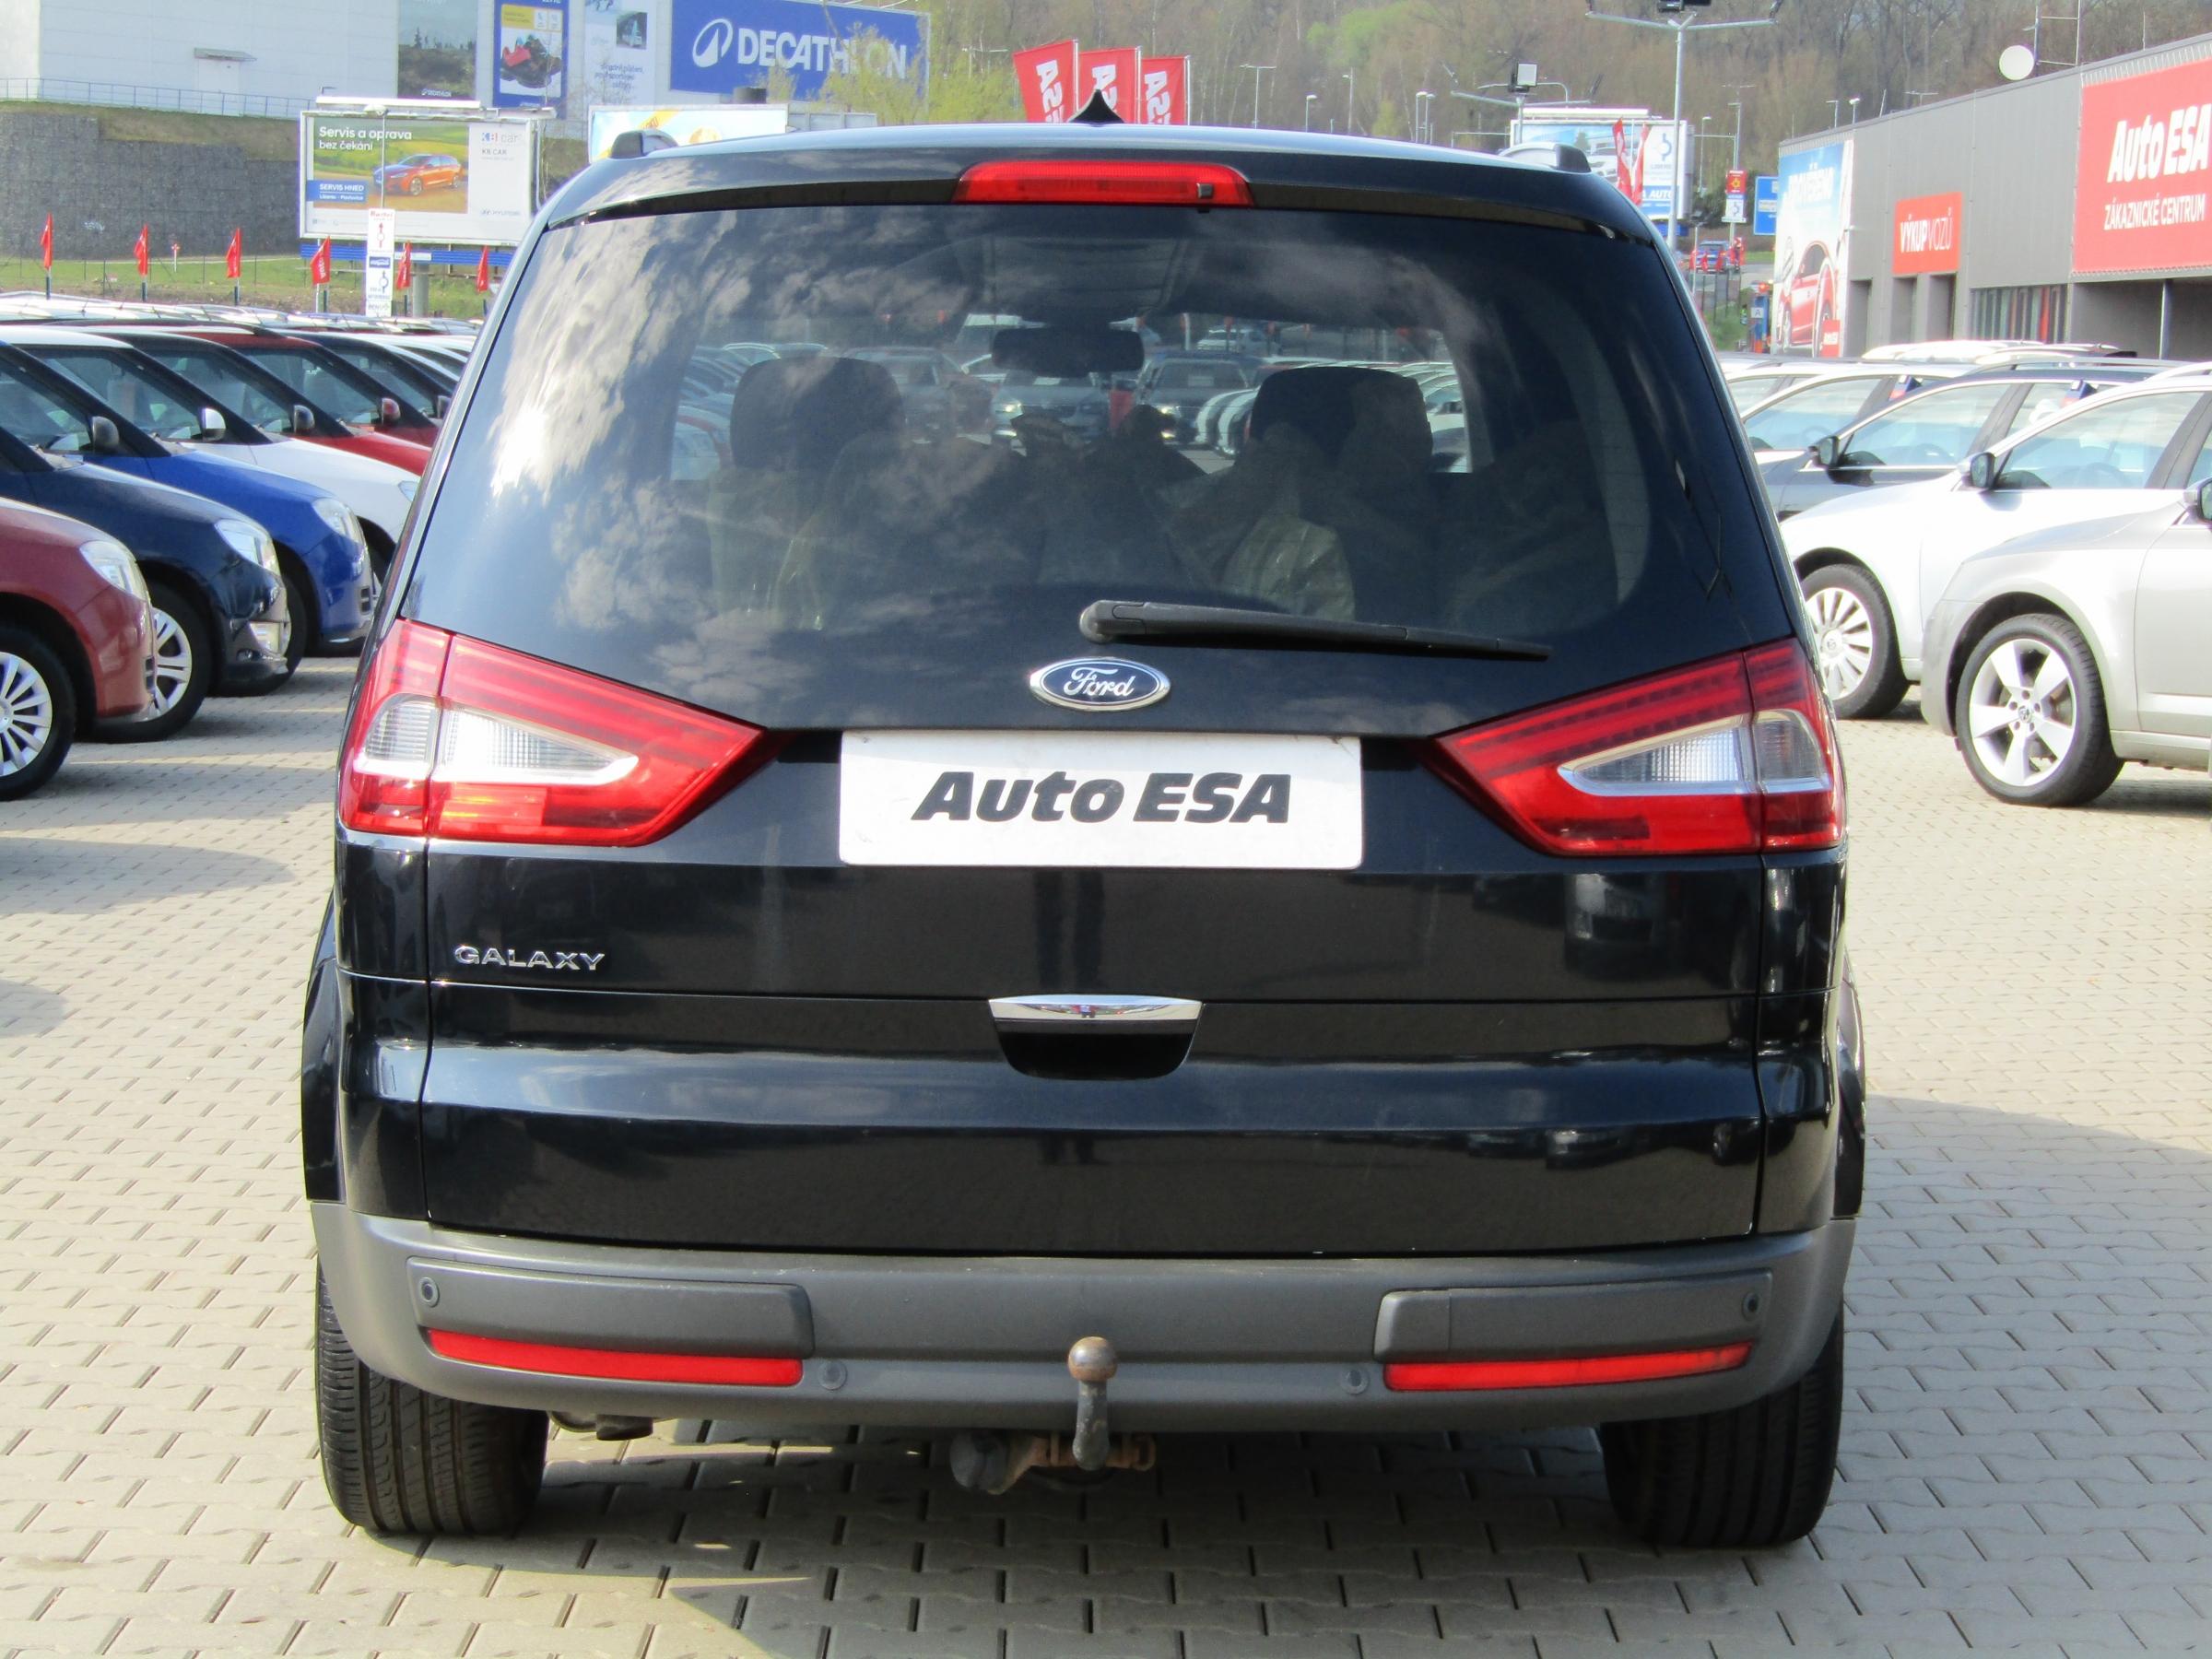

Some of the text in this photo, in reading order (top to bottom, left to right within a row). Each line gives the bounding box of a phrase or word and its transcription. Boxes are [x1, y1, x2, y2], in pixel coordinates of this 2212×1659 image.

[319, 126, 413, 141] Servis a oprava
[319, 140, 337, 149] bez
[2107, 103, 2212, 183] Auto ESA
[319, 183, 344, 192] SERVIS
[2103, 193, 2206, 230] ZÁKAZNICKÉ CENTRUM
[1063, 666, 1135, 698] Ford
[911, 771, 1290, 824] Auto ESA
[453, 945, 606, 971] GALAXY
